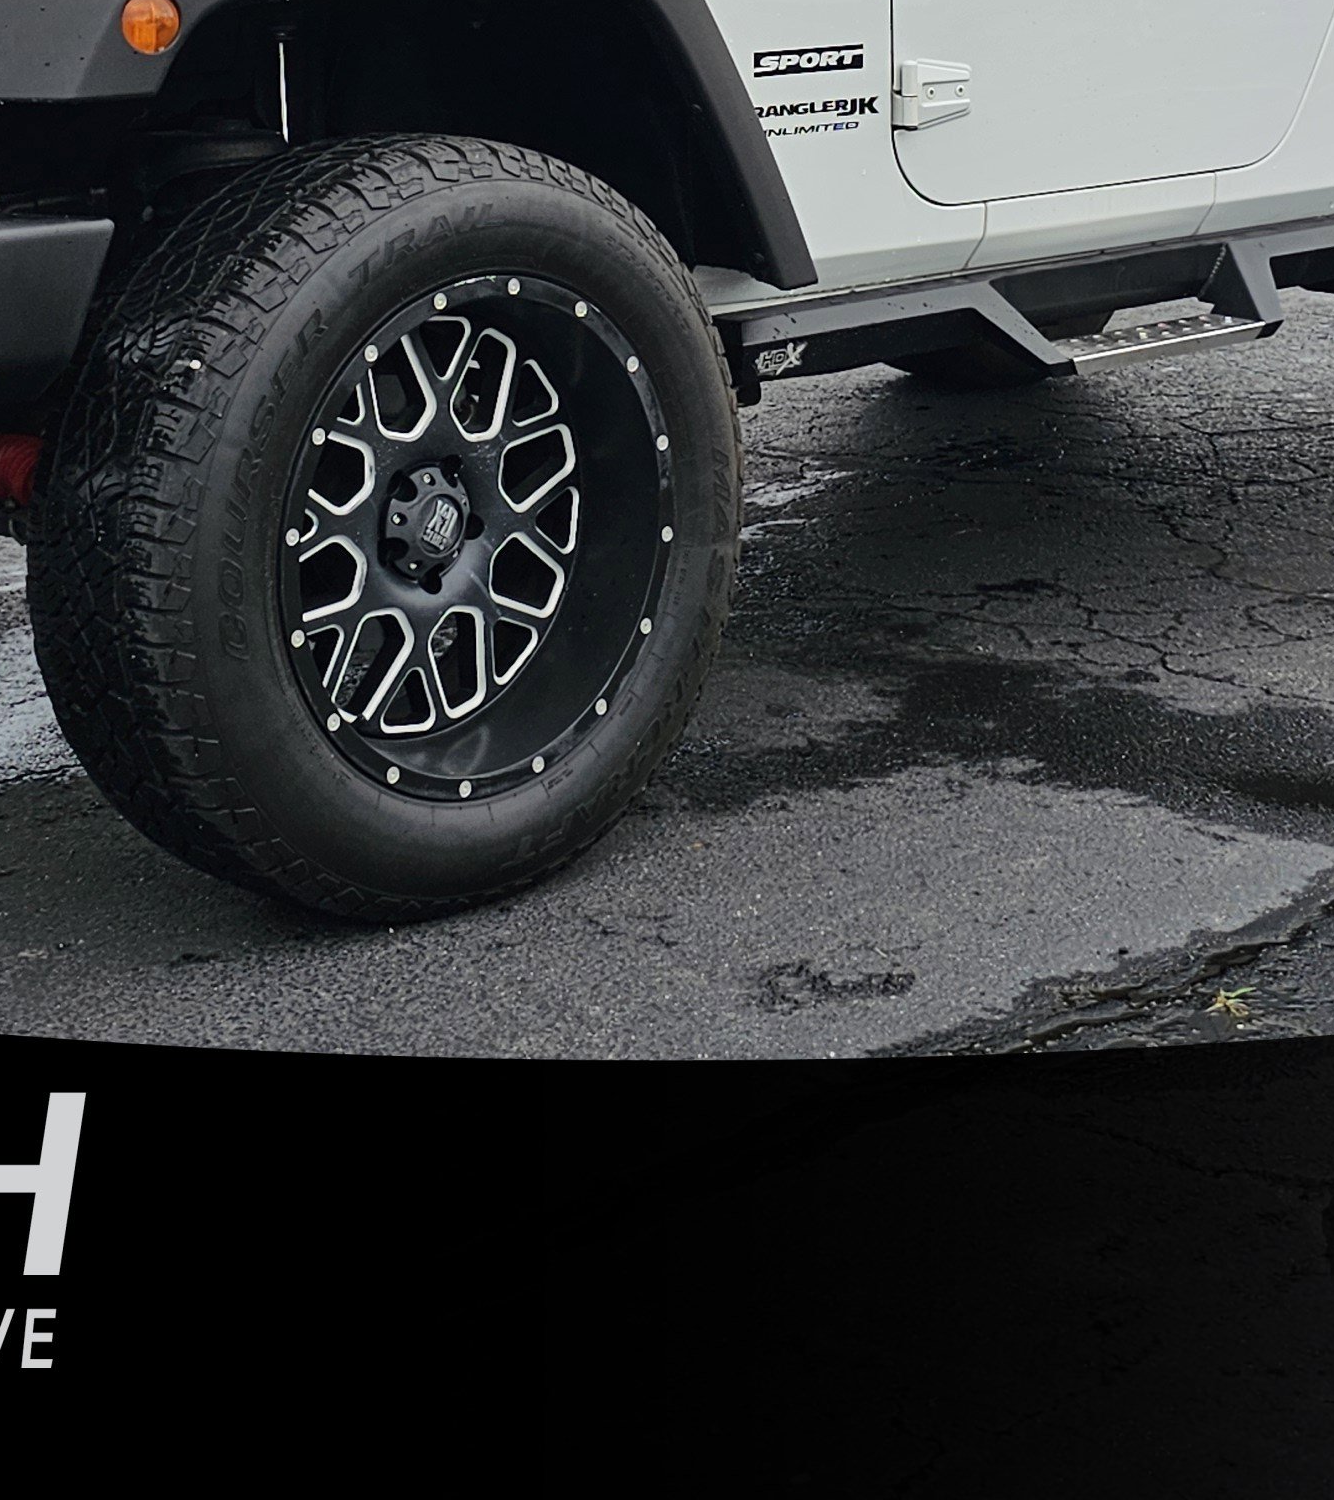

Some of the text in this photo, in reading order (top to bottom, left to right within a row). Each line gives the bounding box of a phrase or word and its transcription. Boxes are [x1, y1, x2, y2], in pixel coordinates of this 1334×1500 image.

[754, 49, 864, 74] SPORT
[754, 100, 850, 119] RANGLER
[765, 121, 859, 137] NLIMITED
[755, 341, 808, 376] HDX
[217, 202, 507, 662] COURSER TRAIL
